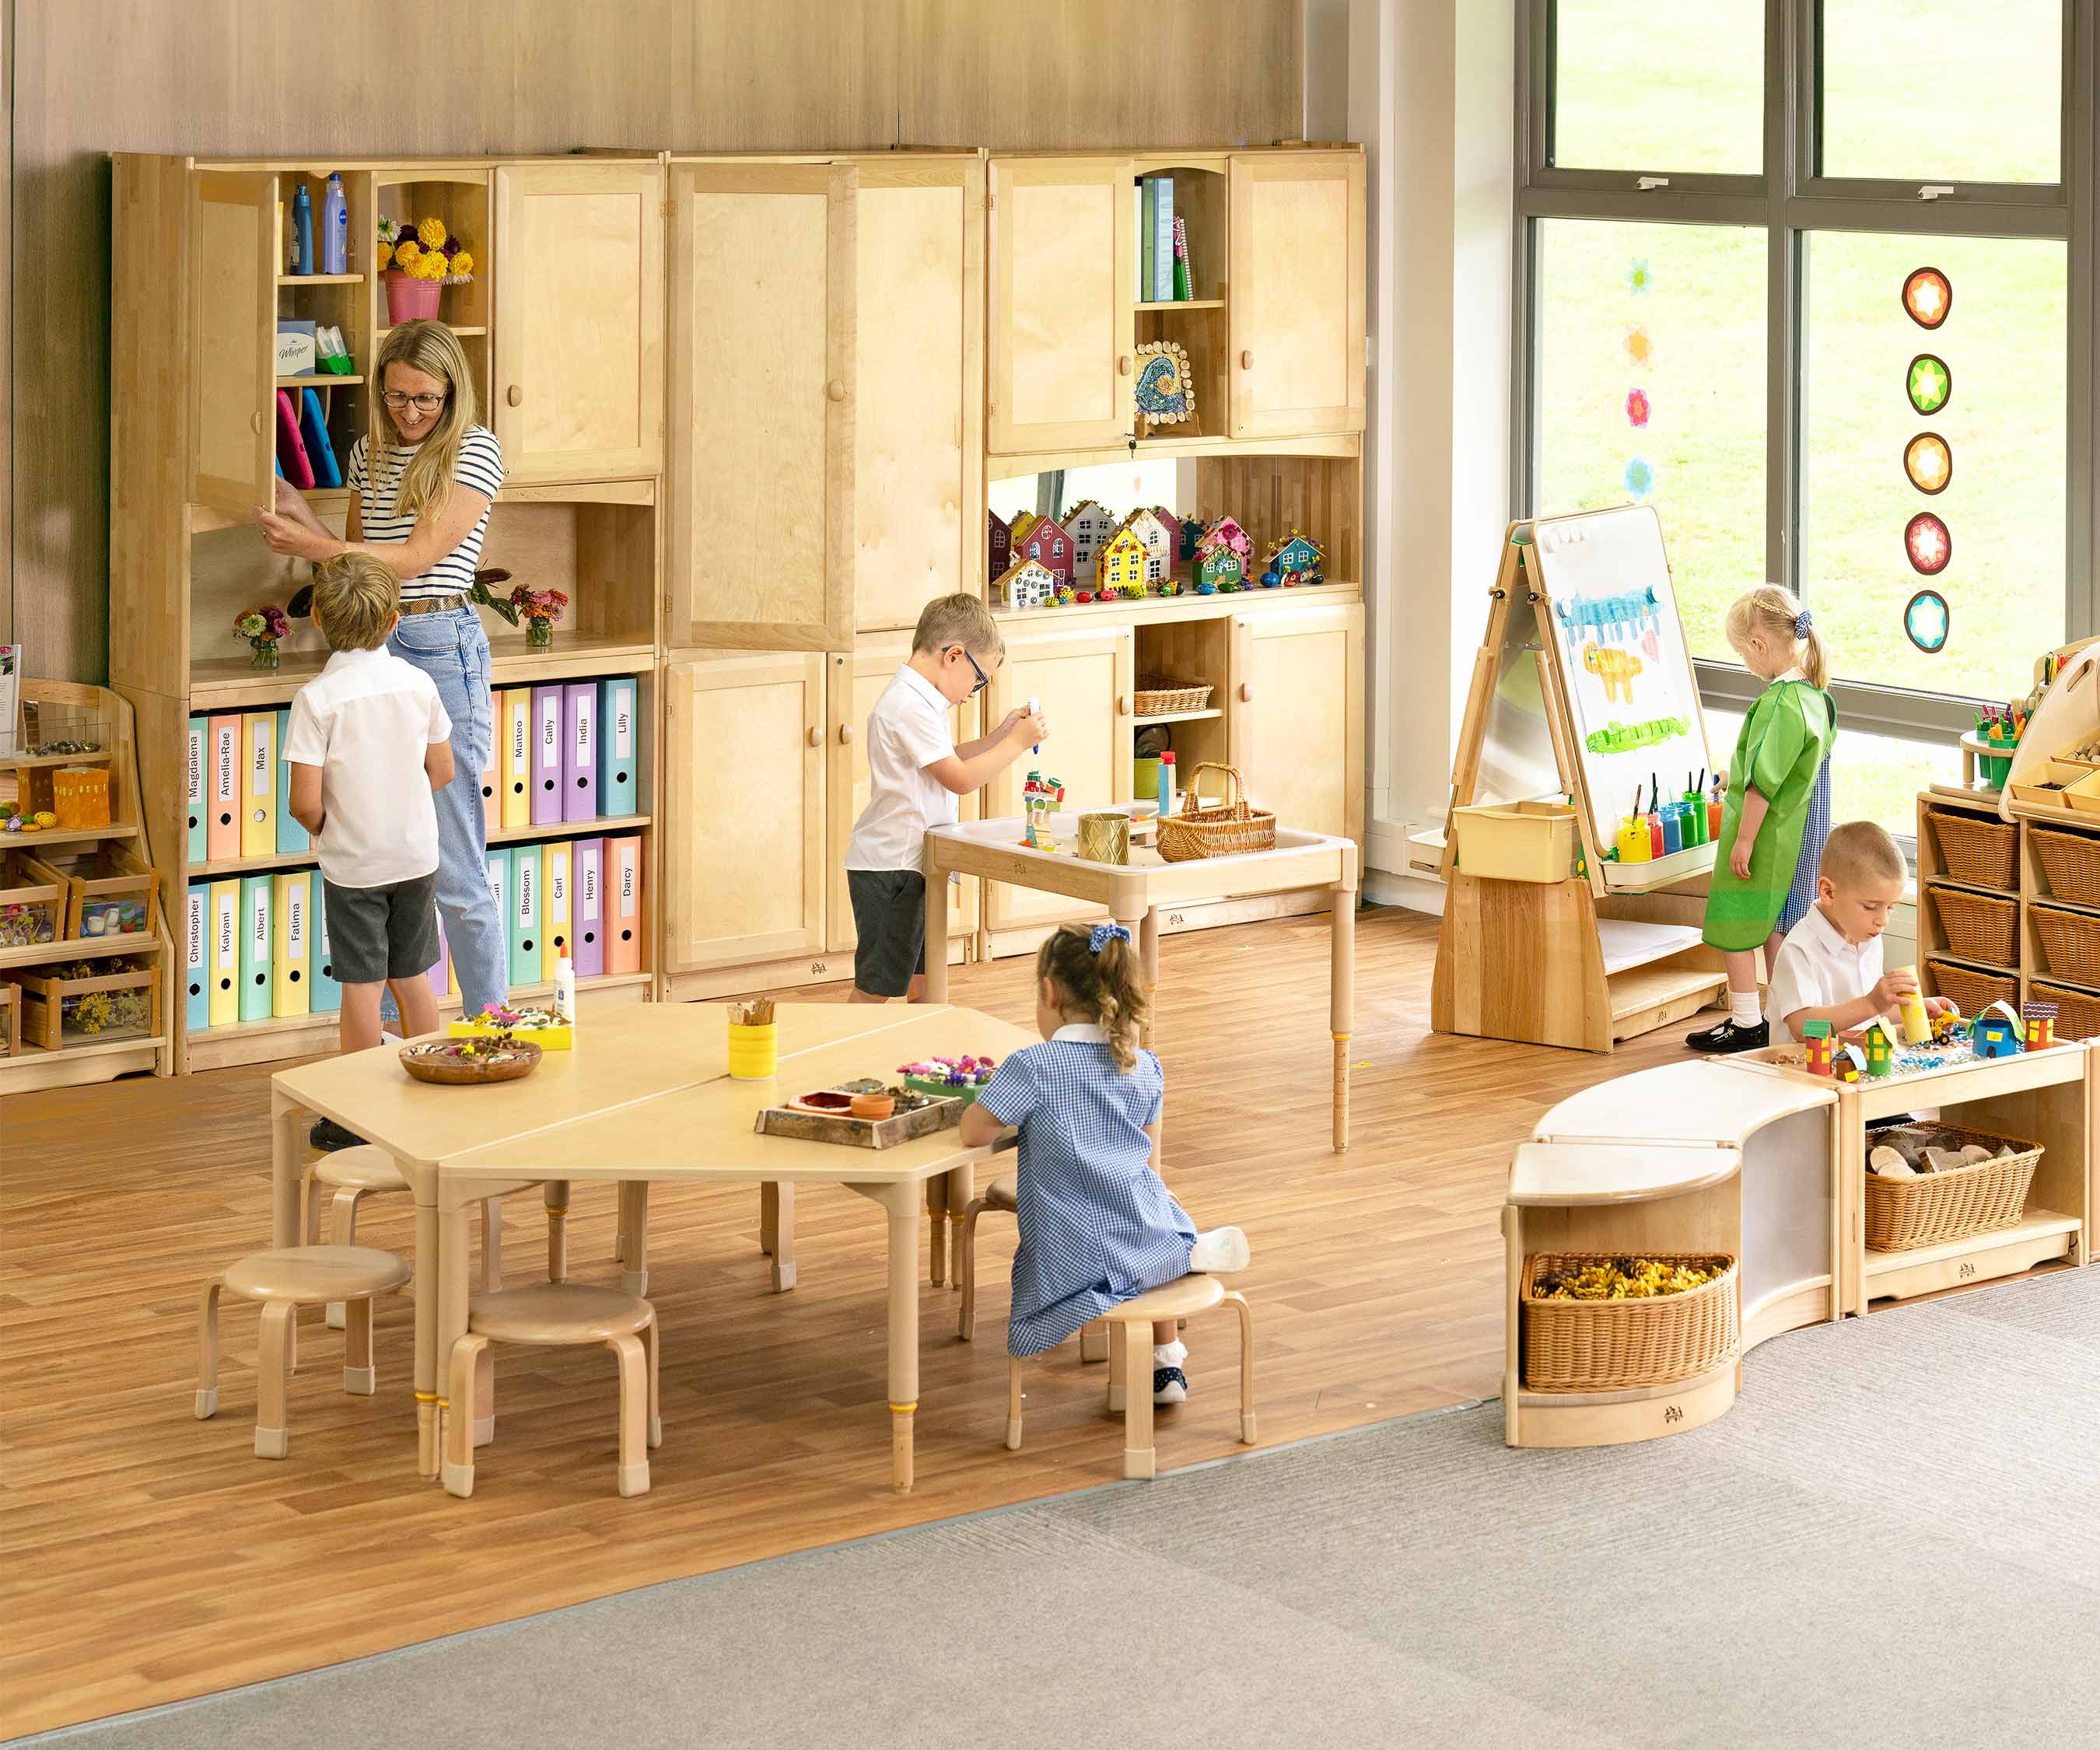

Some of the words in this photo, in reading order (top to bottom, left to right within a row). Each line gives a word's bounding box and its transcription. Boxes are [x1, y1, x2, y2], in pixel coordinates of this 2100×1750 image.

[544, 719, 555, 744] Cally
[578, 719, 588, 744] India
[618, 713, 628, 733] Lilly
[188, 737, 200, 797] Magdalena
[221, 733, 230, 796] Amelia-Rae
[256, 747, 265, 770] Max
[521, 870, 530, 915] Blossom
[554, 878, 562, 899] Carl
[586, 870, 595, 900] Henry
[622, 867, 633, 897] Darcy
[189, 899, 200, 963] Christopher
[222, 912, 231, 953] Kalyani
[257, 908, 265, 940] Albert
[291, 903, 300, 941] Fatima
